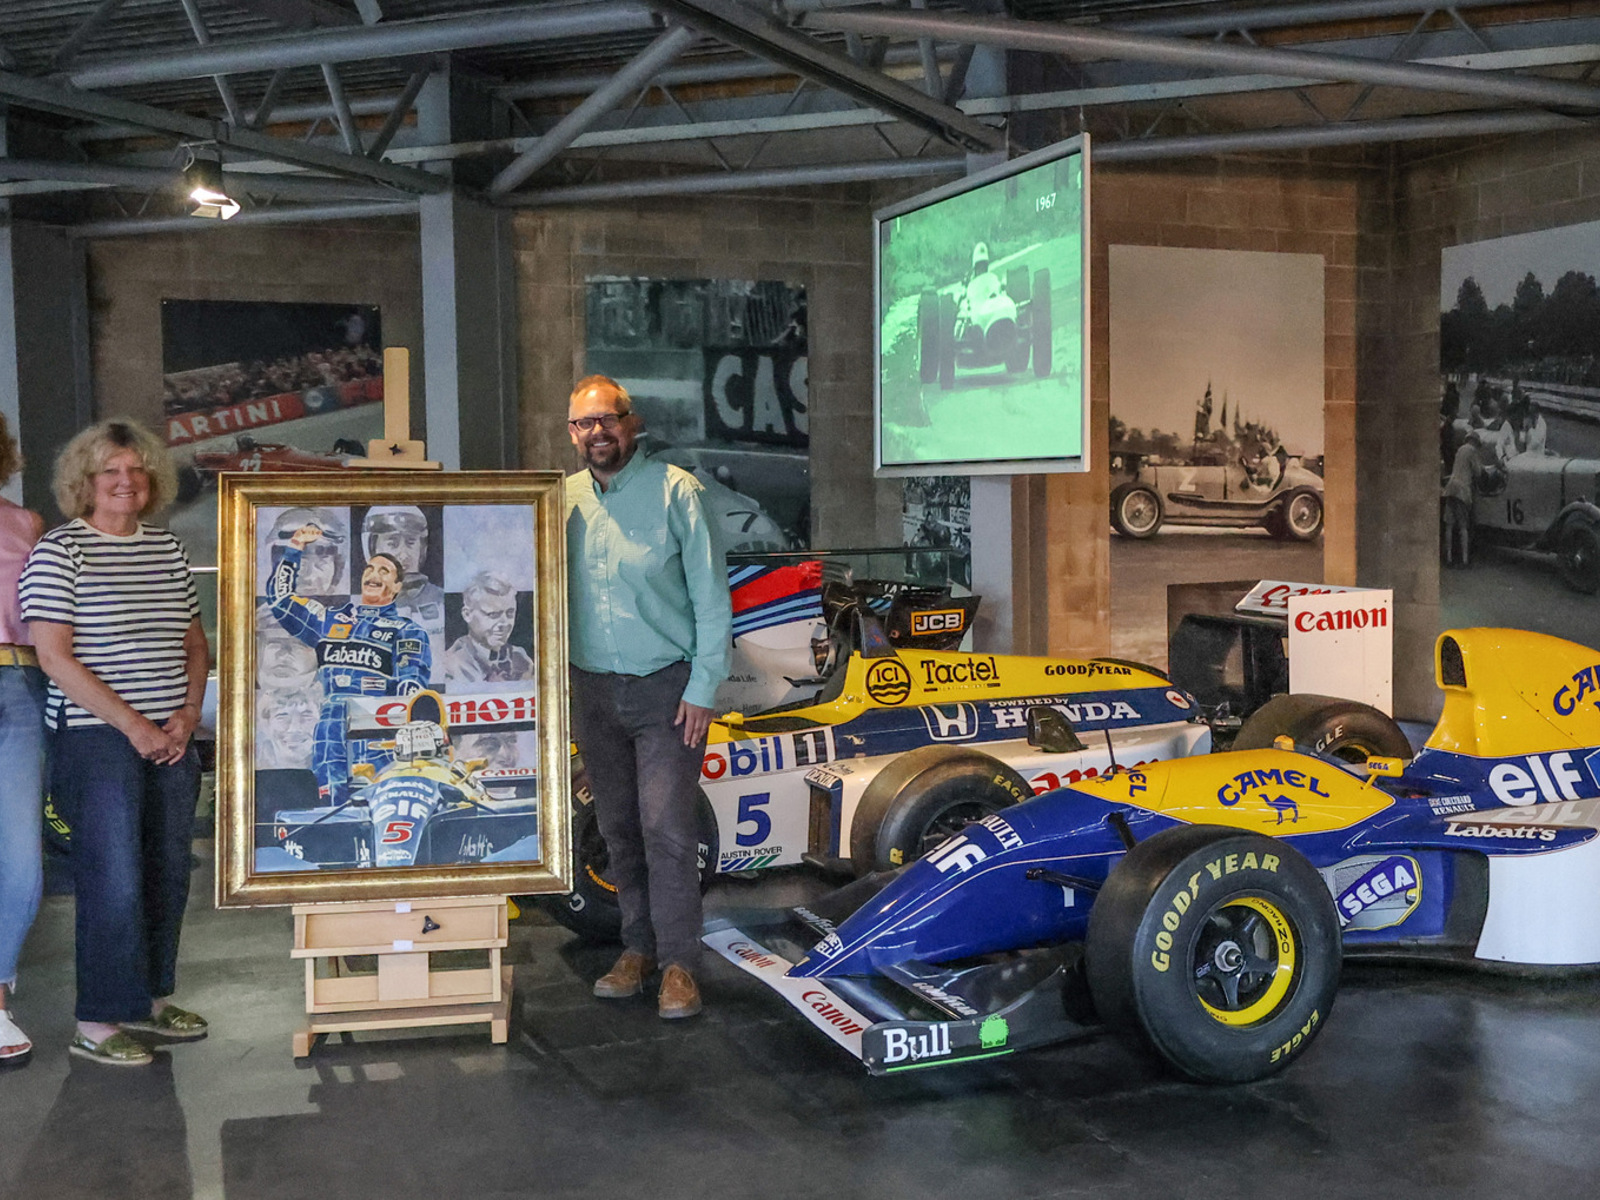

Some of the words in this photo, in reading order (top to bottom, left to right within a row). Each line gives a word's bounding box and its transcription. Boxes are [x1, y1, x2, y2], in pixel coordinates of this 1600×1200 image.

[1036, 192, 1056, 212] 1967
[726, 511, 758, 533] 7
[1506, 498, 1525, 526] 16
[915, 613, 961, 632] JCB
[1295, 607, 1388, 633] Canon
[371, 630, 394, 642] elf
[323, 644, 382, 668] Labatt's
[876, 667, 899, 683] ICI
[920, 656, 1000, 684] Tactel
[989, 697, 1052, 708] POWERED
[1553, 664, 1600, 716] CA
[375, 698, 535, 727] Cnon
[992, 701, 1141, 730] HNDA
[1368, 761, 1389, 771] SEGA
[1217, 768, 1330, 806] CAMEL
[1489, 752, 1582, 808] elf
[736, 792, 771, 847] 5
[1432, 804, 1476, 816] RENAULT
[382, 821, 415, 844] 5
[1445, 823, 1557, 841] Labatt's
[721, 849, 751, 860] AUSTIN
[754, 846, 783, 855] ROVER
[1342, 865, 1415, 916] SEGA
[727, 941, 777, 968] Canon
[802, 990, 864, 1036] Canon
[883, 1022, 952, 1063] Bull
[1269, 1008, 1320, 1063] EAGLE
